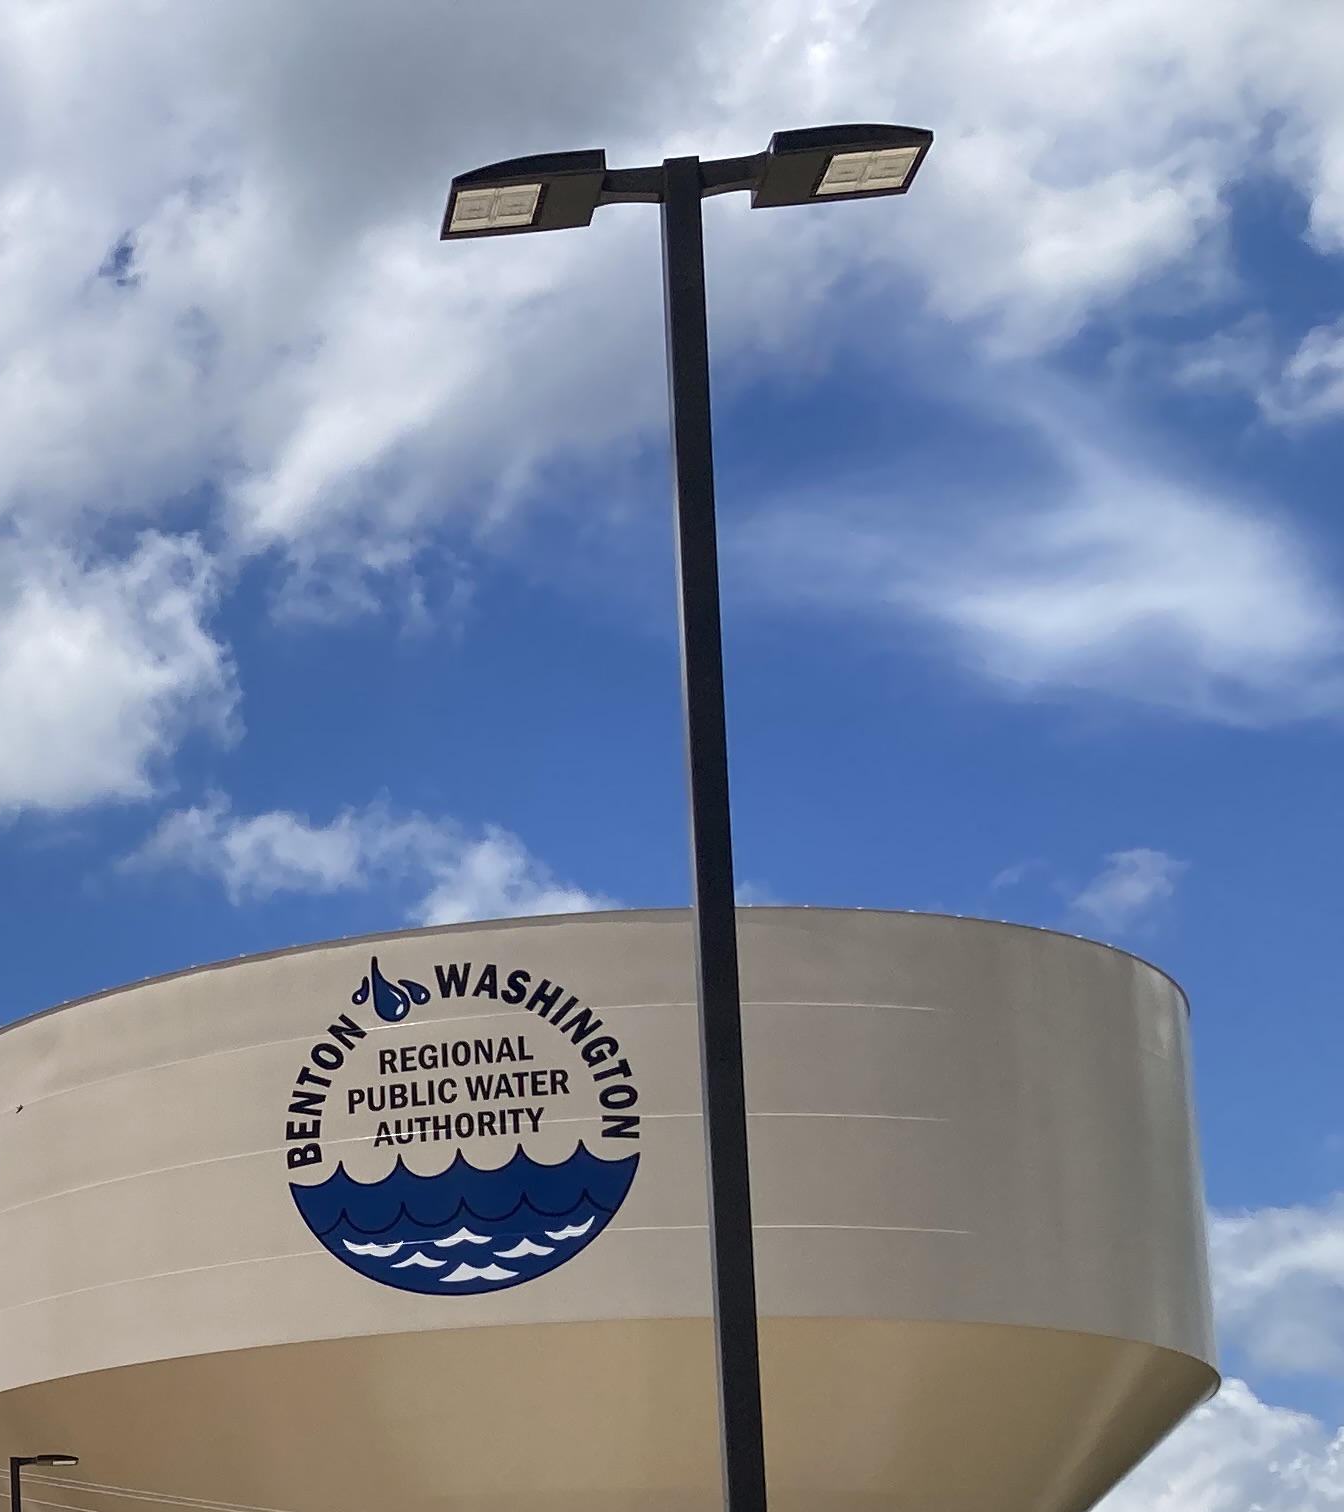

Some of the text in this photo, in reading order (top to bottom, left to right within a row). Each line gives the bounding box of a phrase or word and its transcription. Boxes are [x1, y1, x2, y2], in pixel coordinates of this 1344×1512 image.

[286, 962, 641, 1169] BENTON WASHINGTON
[378, 1035, 534, 1075] REGIONAL
[347, 1068, 571, 1115] PUBLIC WATER
[373, 1106, 545, 1148] AUTHORITY
